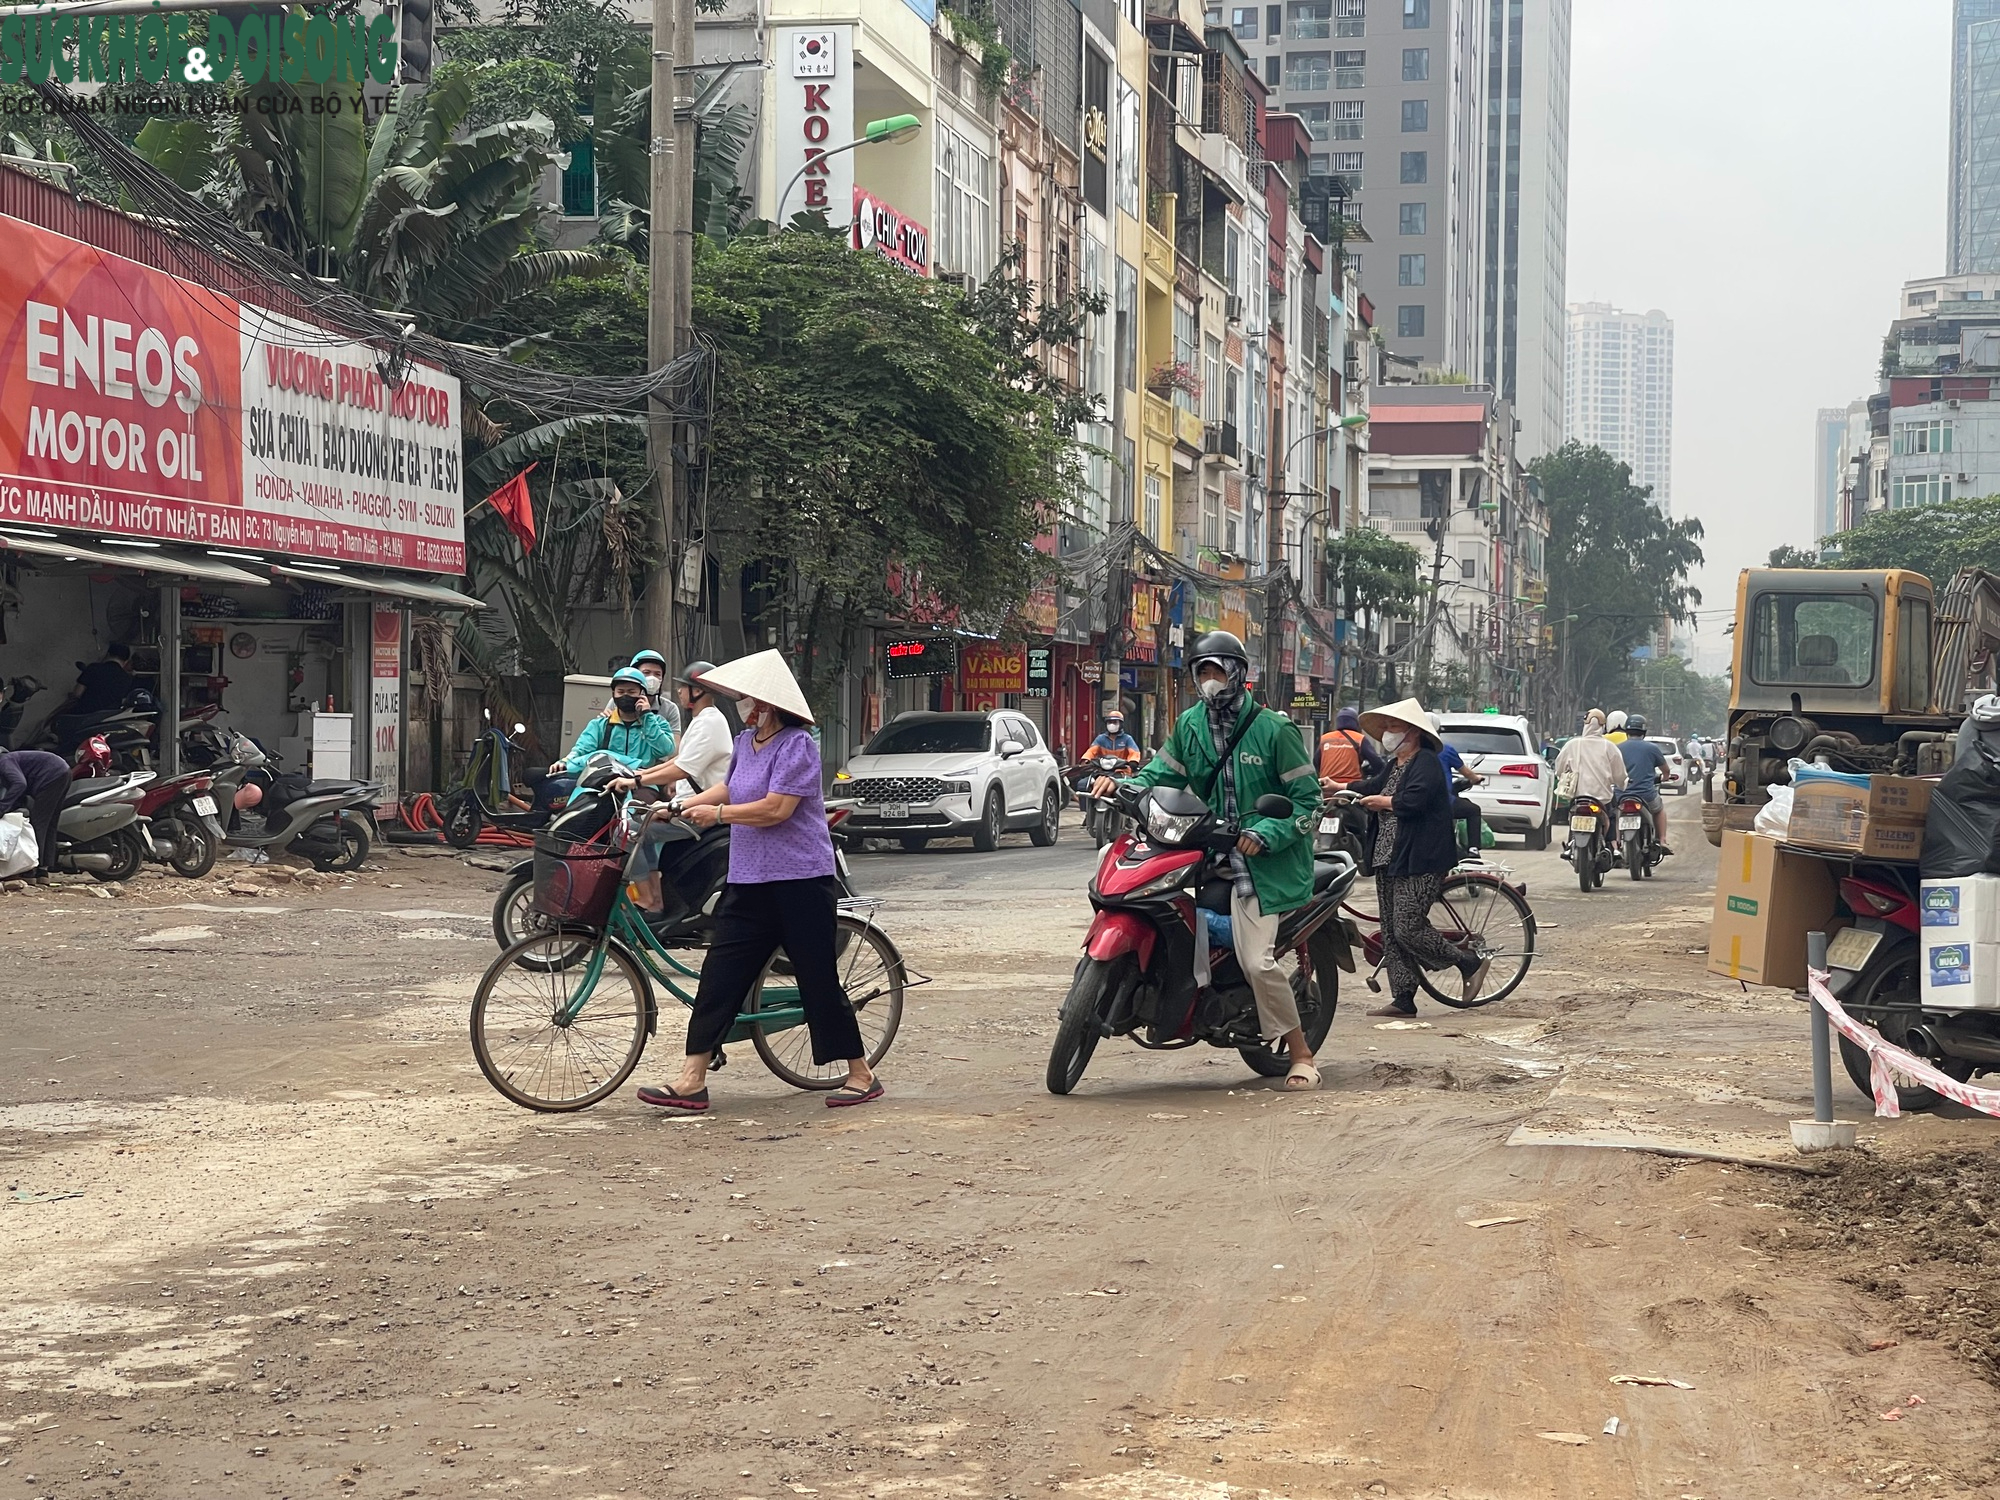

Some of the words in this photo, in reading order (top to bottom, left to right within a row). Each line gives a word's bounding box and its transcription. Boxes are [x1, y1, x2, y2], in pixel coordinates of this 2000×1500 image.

[804, 84, 830, 207] KORE
[27, 300, 202, 414] ENEOS
[264, 343, 333, 400] VƯƠNG
[336, 362, 385, 413] PHÁT
[388, 379, 450, 428] MOTOR
[28, 406, 147, 474] MOTOR
[156, 428, 202, 482] OIL
[250, 398, 275, 459] SỬA
[279, 411, 312, 467] CHỮA
[322, 414, 346, 474] BẢO
[350, 424, 388, 481] DƯỠNG
[391, 436, 404, 484] XE
[407, 441, 422, 487] GA
[430, 446, 443, 491] XE
[445, 440, 458, 494] SỐ
[26, 489, 77, 522] MẠNH
[80, 490, 114, 526] DẦU
[118, 500, 163, 532] NHỚT
[167, 506, 207, 539] NHẬT
[210, 509, 240, 541] BẢN
[255, 474, 294, 503] HONDA
[302, 481, 344, 511] YAMAHA
[353, 491, 391, 519] PIAGGIO
[399, 499, 417, 523] SYM
[425, 503, 455, 529] SUZUKI
[262, 519, 271, 541] 73
[273, 518, 299, 549] Nguyễn
[300, 525, 313, 550] Huy
[315, 526, 338, 555] Tưởng
[342, 530, 362, 554] Thanh
[966, 652, 1022, 674] VÀNG
[390, 693, 398, 713] XE
[1240, 751, 1264, 766] Gra
